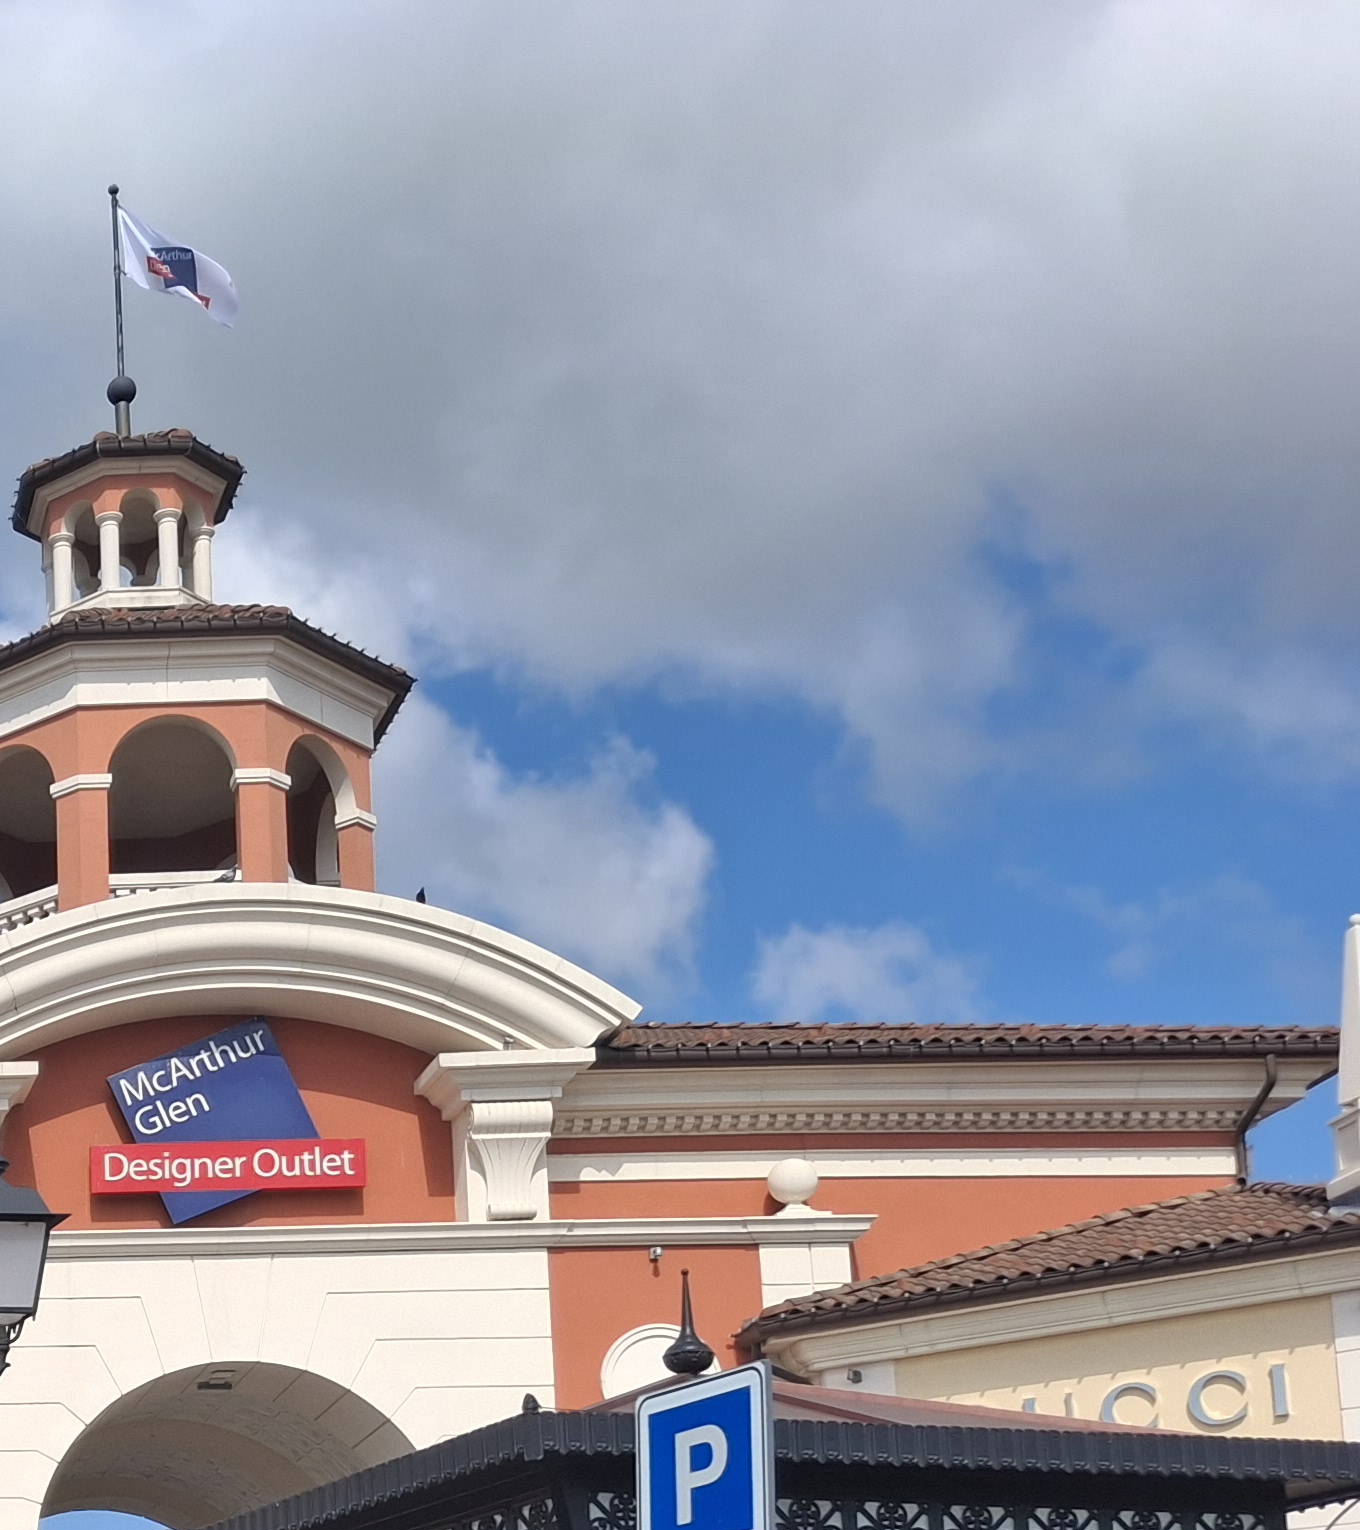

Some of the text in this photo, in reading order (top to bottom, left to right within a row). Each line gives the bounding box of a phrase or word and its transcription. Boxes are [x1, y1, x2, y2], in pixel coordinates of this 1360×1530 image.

[119, 1027, 267, 1107] McArthur
[134, 1089, 210, 1136] Glen
[103, 1146, 355, 1187] Designer Outlet
[675, 1424, 729, 1526] P
